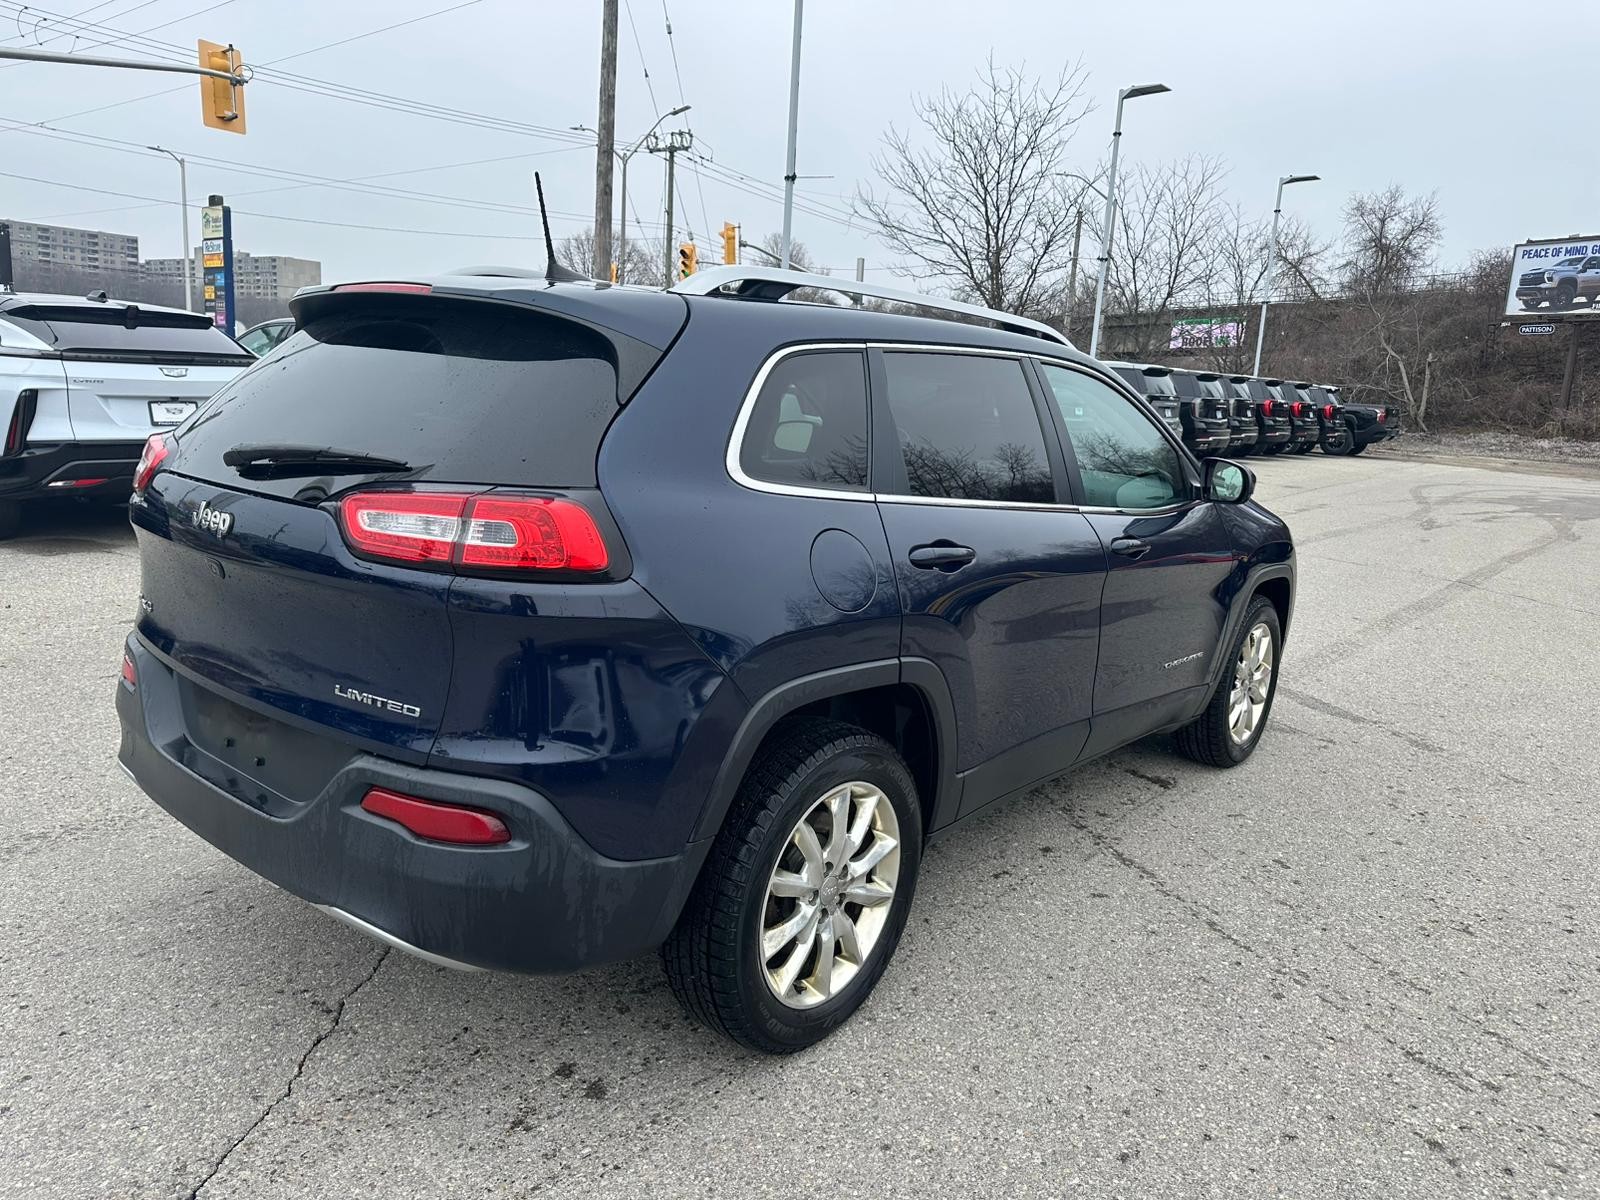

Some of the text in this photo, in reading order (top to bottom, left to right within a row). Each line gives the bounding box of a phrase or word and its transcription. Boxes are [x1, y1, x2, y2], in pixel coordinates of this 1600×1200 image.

[1522, 248, 1550, 259] PEACE
[1551, 247, 1563, 258] OF
[192, 500, 231, 538] Jeep
[335, 684, 421, 718] LIMITED
